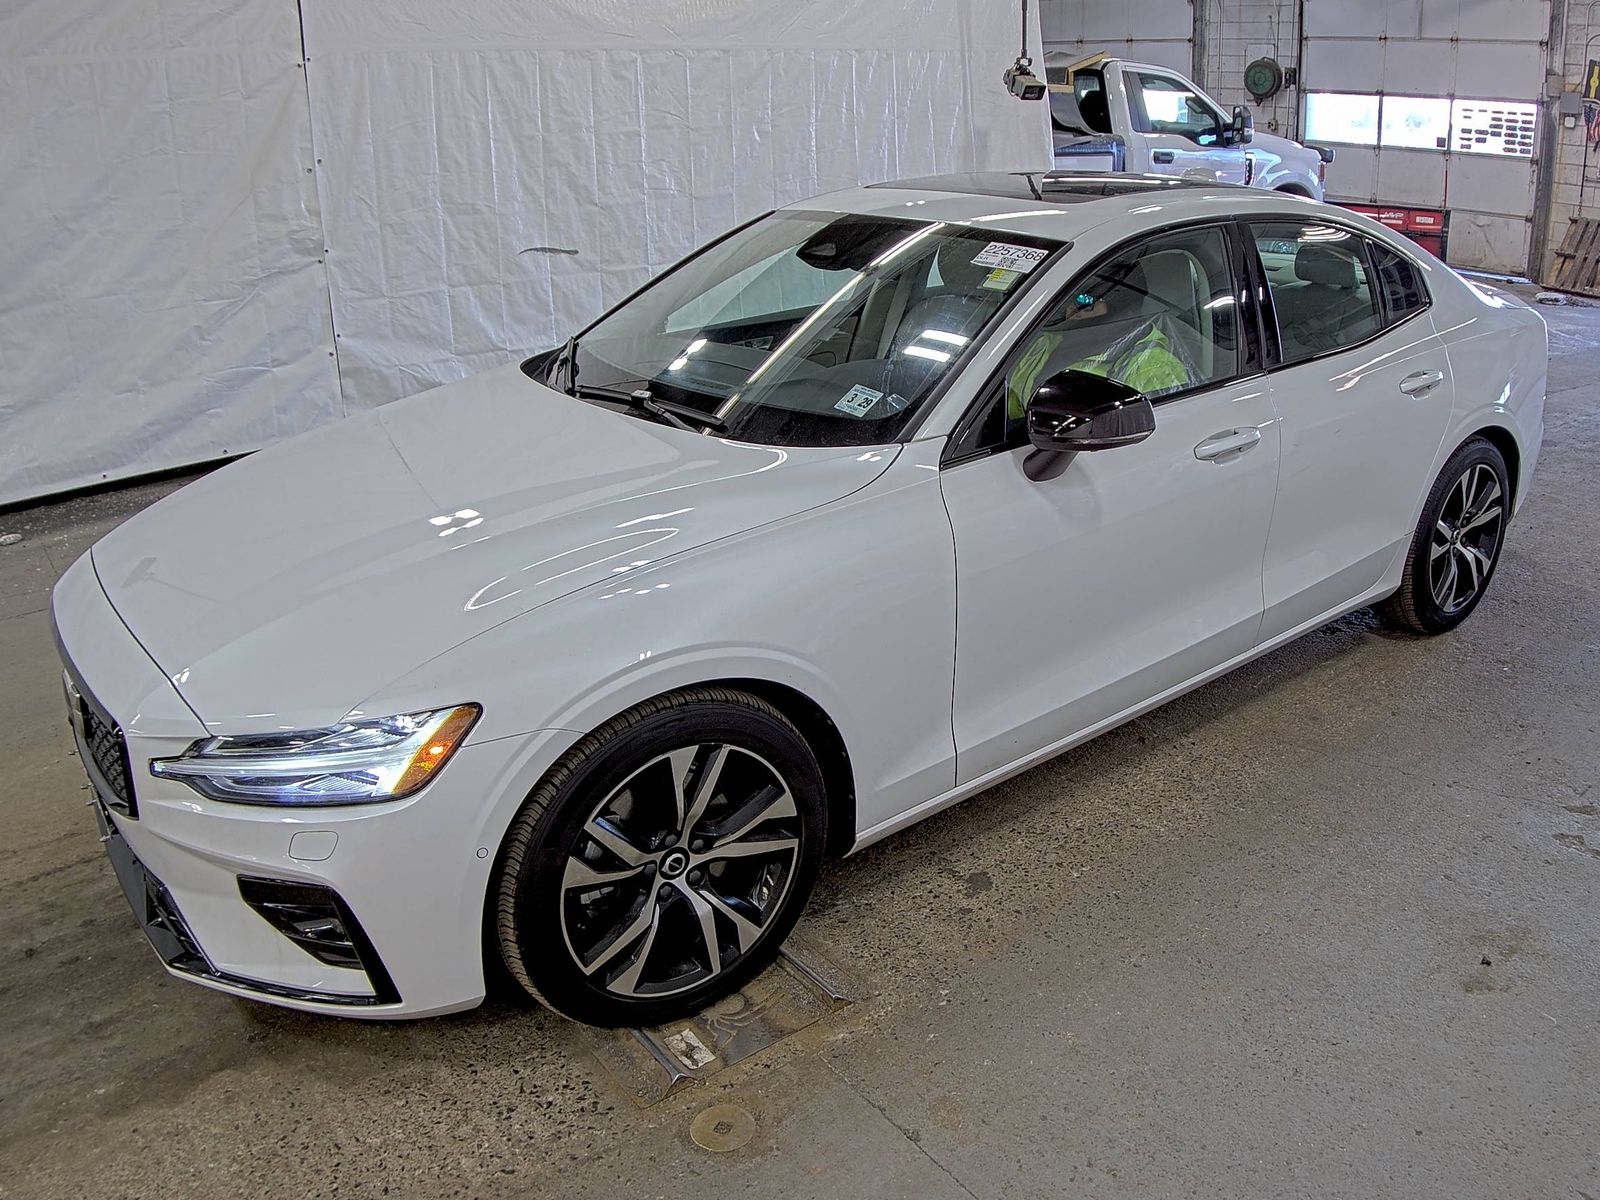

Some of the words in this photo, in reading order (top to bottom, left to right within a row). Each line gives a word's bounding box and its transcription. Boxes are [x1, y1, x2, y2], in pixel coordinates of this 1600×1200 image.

[984, 244, 1045, 261] 2257368
[847, 393, 858, 403] 3
[856, 397, 874, 409] 29
